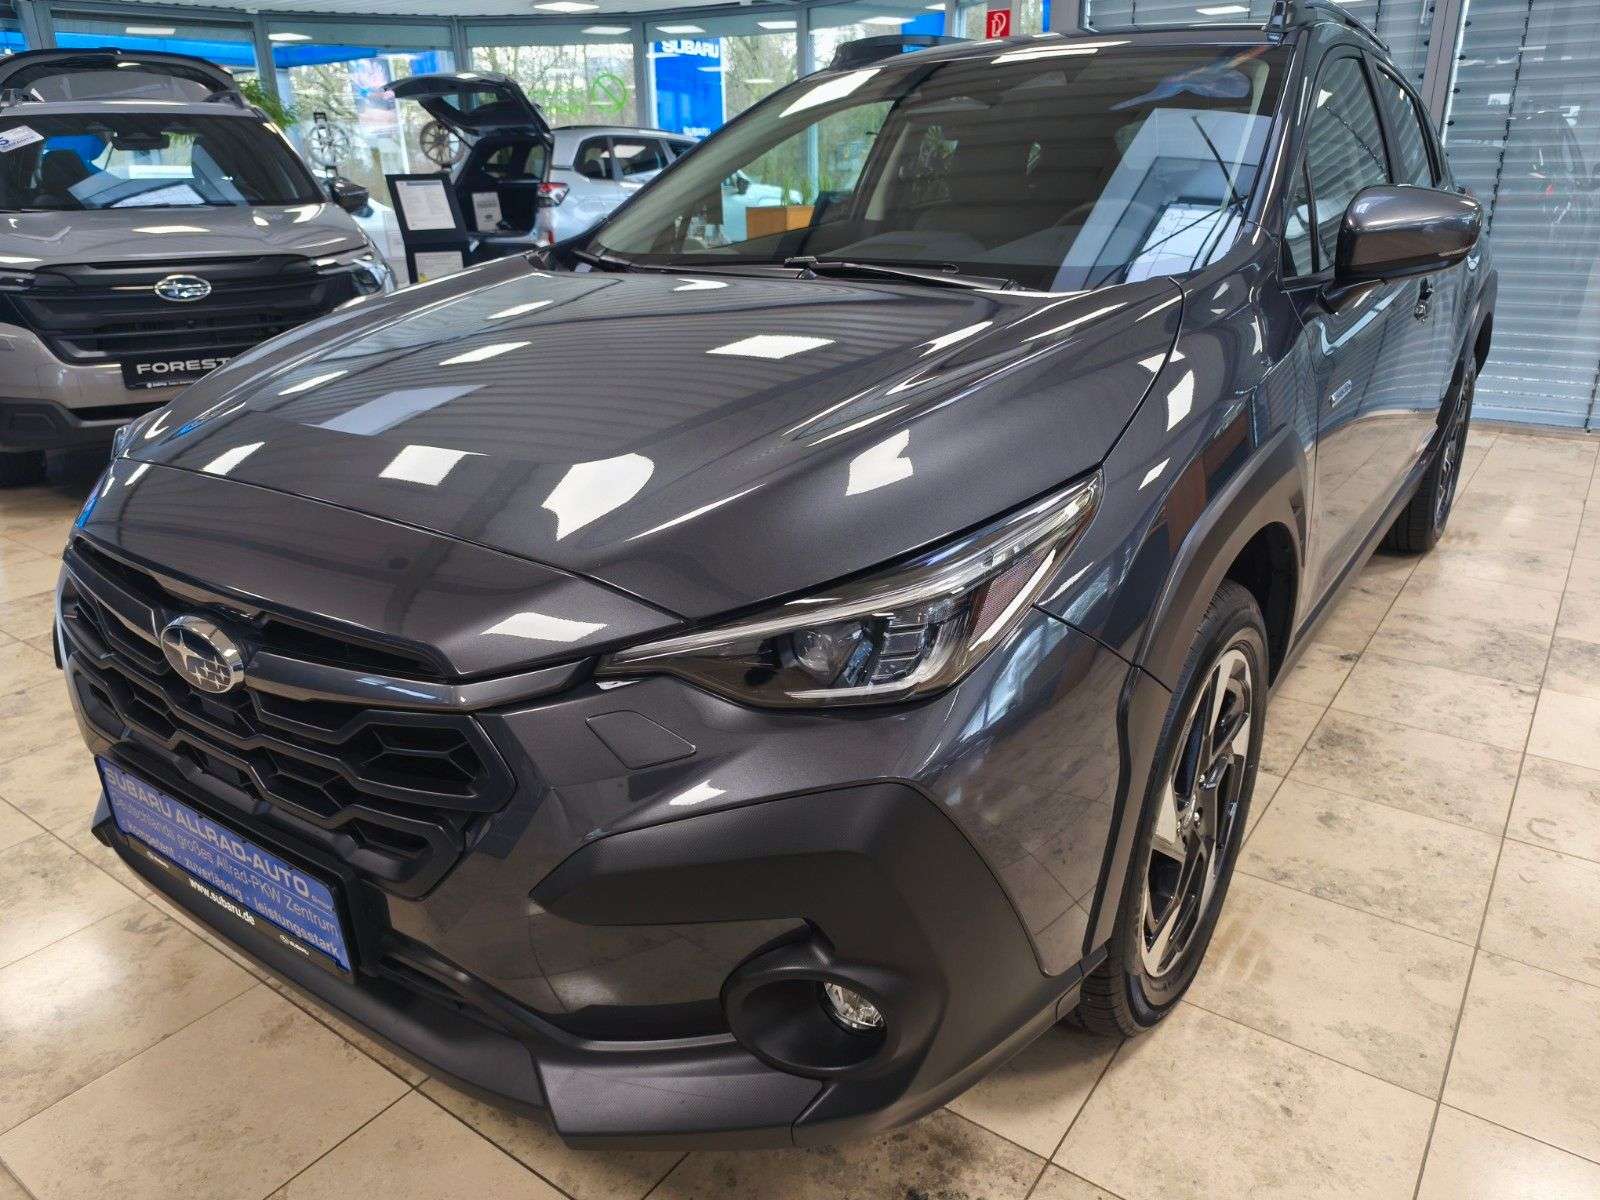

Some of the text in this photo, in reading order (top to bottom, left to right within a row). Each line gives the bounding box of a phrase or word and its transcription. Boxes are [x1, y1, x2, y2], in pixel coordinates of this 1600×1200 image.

[661, 40, 719, 58] SUBARU
[104, 767, 310, 898] SUBARU ALLRAD-AUTO
[188, 877, 256, 926] www.subaru.de
[282, 893, 339, 938] Zentrum
